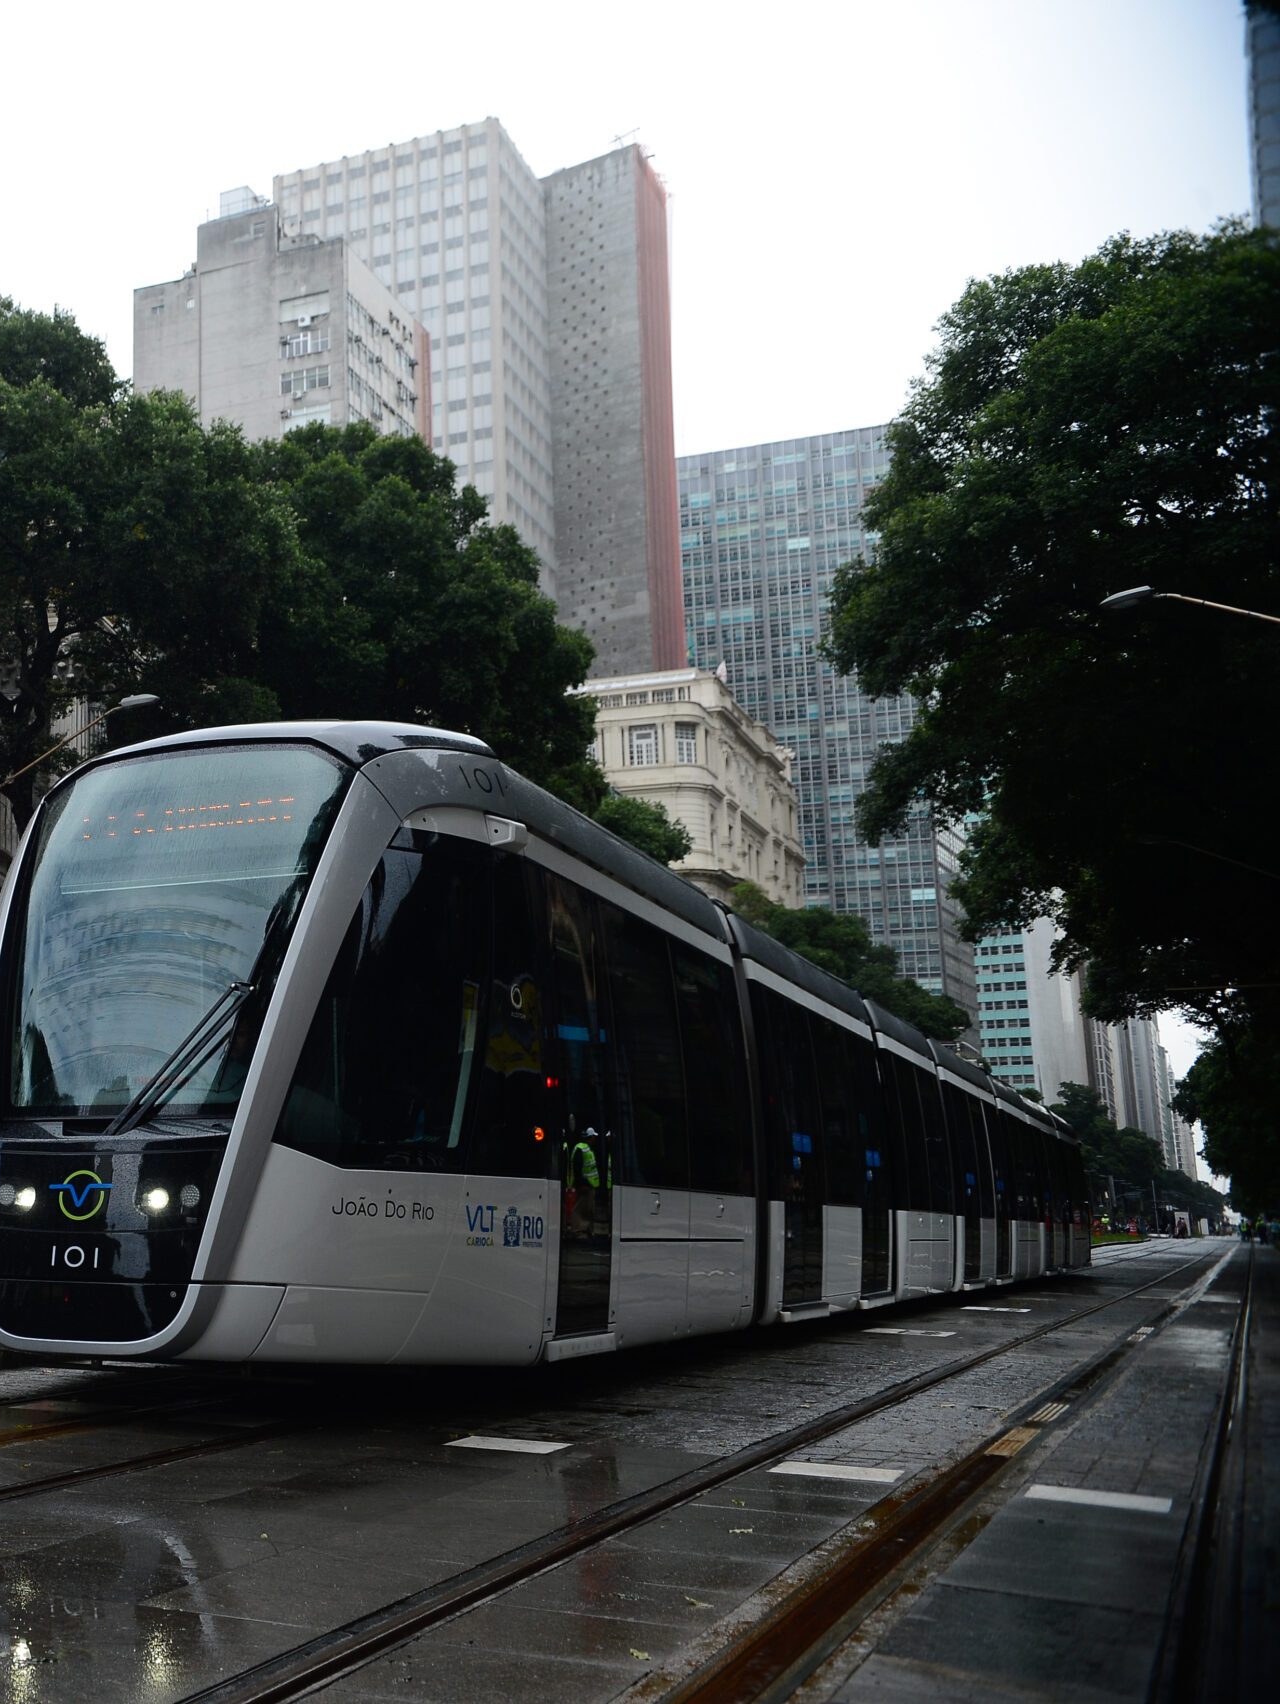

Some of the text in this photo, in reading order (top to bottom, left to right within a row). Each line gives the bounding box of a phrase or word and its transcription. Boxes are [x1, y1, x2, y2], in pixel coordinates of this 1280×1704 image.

[458, 764, 505, 798] 101
[465, 1204, 498, 1232] VLT
[522, 1215, 544, 1239] RIO
[466, 1236, 495, 1248] CARIOCA
[51, 1245, 99, 1269] 101
